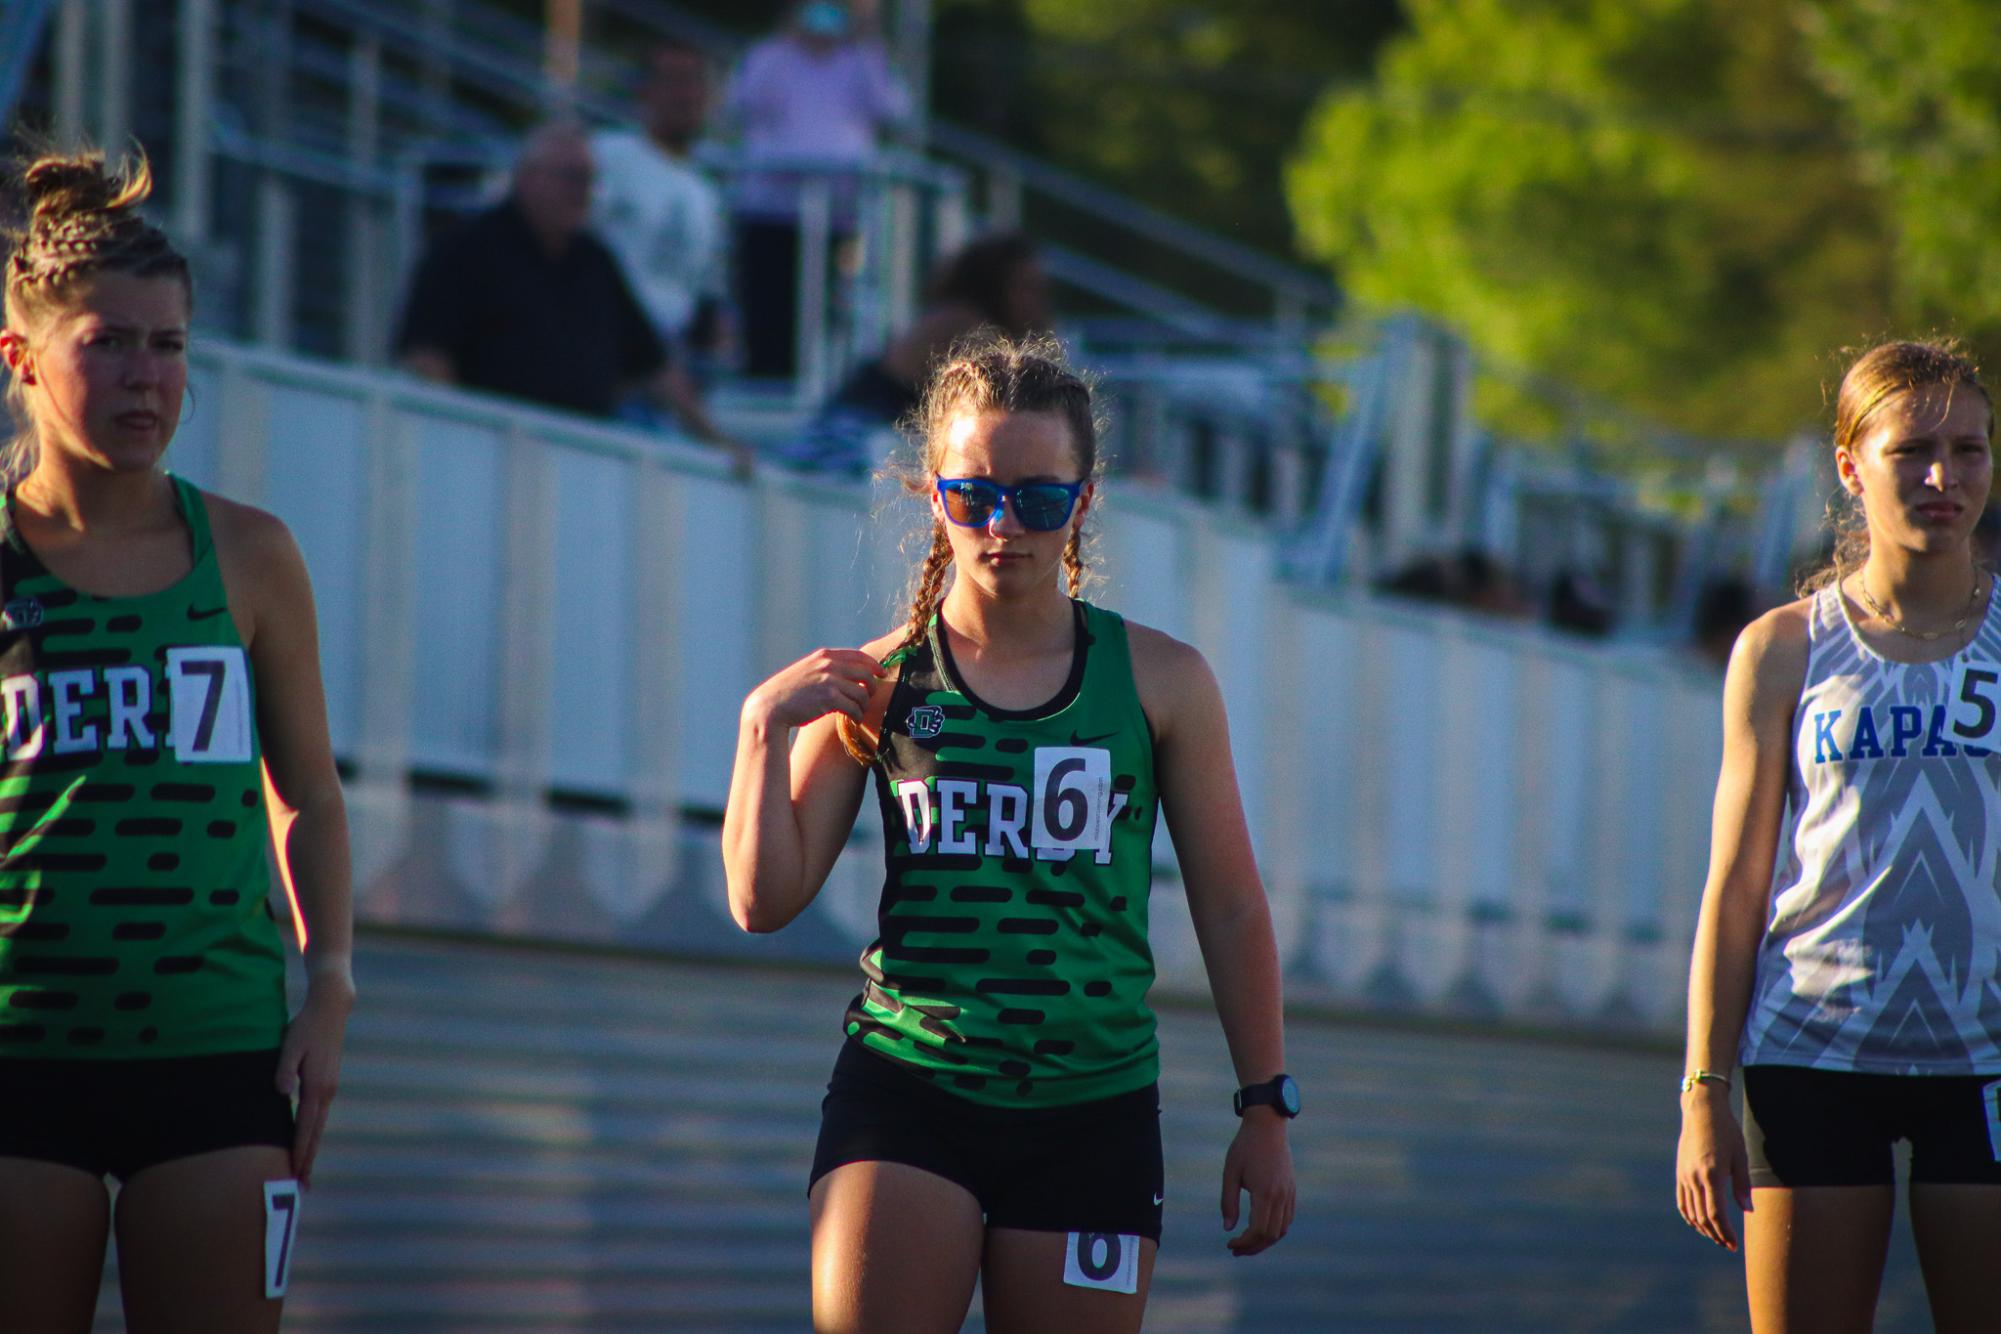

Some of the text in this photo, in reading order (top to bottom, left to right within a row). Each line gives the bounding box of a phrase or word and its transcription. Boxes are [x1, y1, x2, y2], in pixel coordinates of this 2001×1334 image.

[0, 666, 177, 761] DER
[180, 660, 226, 753] 7
[1814, 704, 1993, 764] KAPA
[1953, 668, 1999, 739] 5
[897, 778, 1129, 866] DERY
[1043, 757, 1089, 842] 6
[272, 1193, 296, 1288] 7
